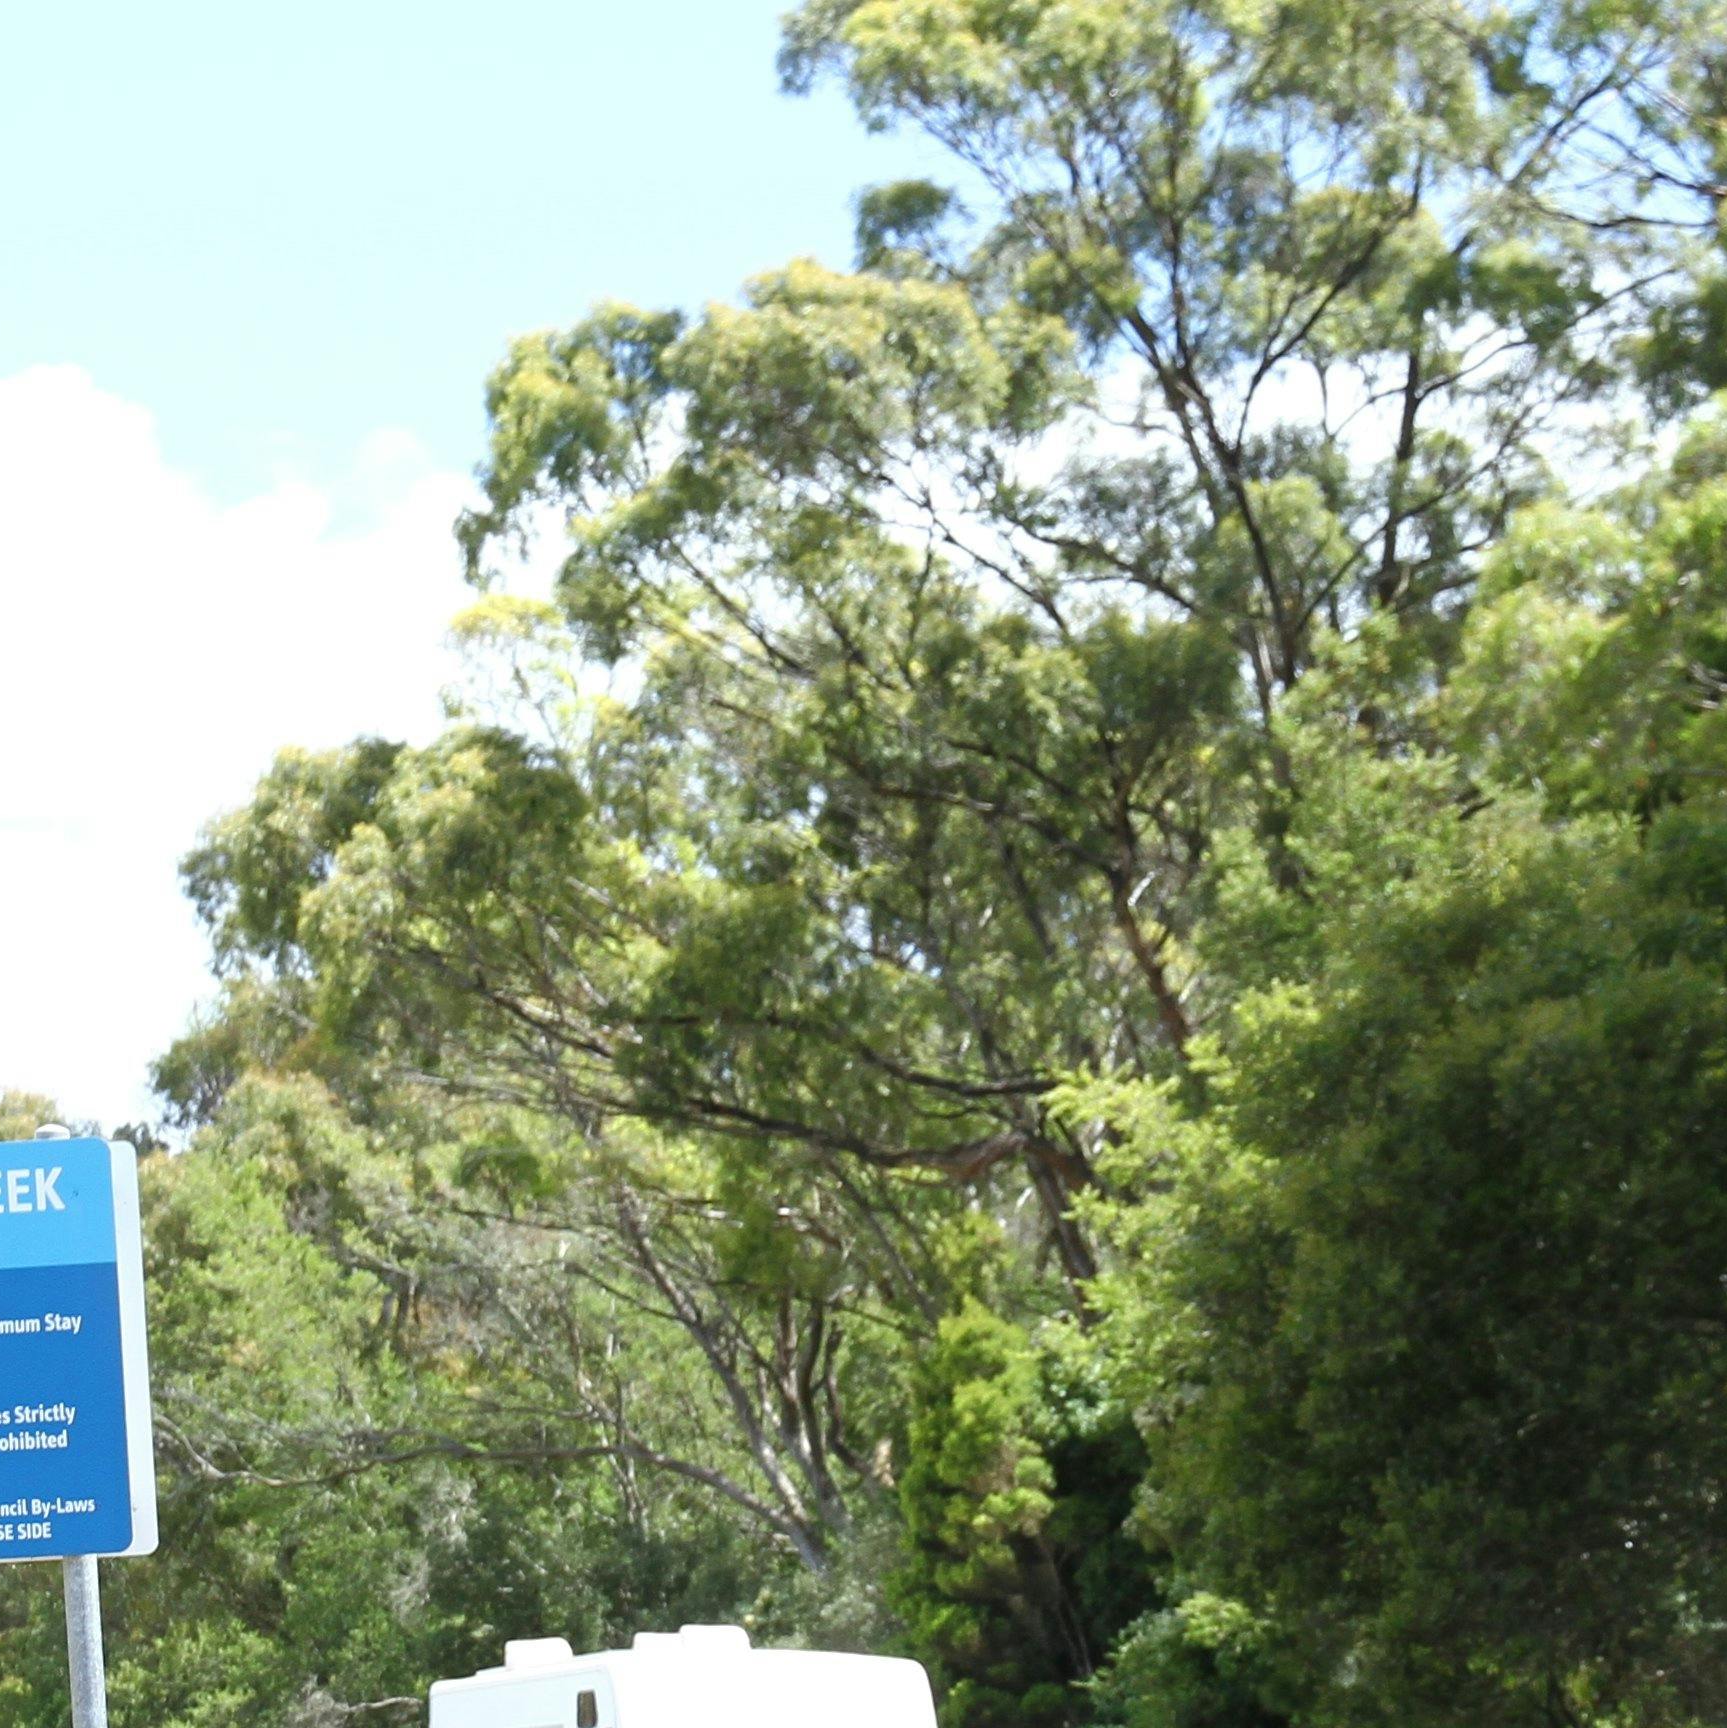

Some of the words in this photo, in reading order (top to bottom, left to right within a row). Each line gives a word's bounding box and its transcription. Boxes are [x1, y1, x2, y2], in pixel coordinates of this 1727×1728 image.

[44, 1313, 82, 1334] Stay
[14, 1402, 76, 1425] Strictly
[31, 1497, 96, 1519] By-Laws
[17, 1522, 52, 1541] SIDE
